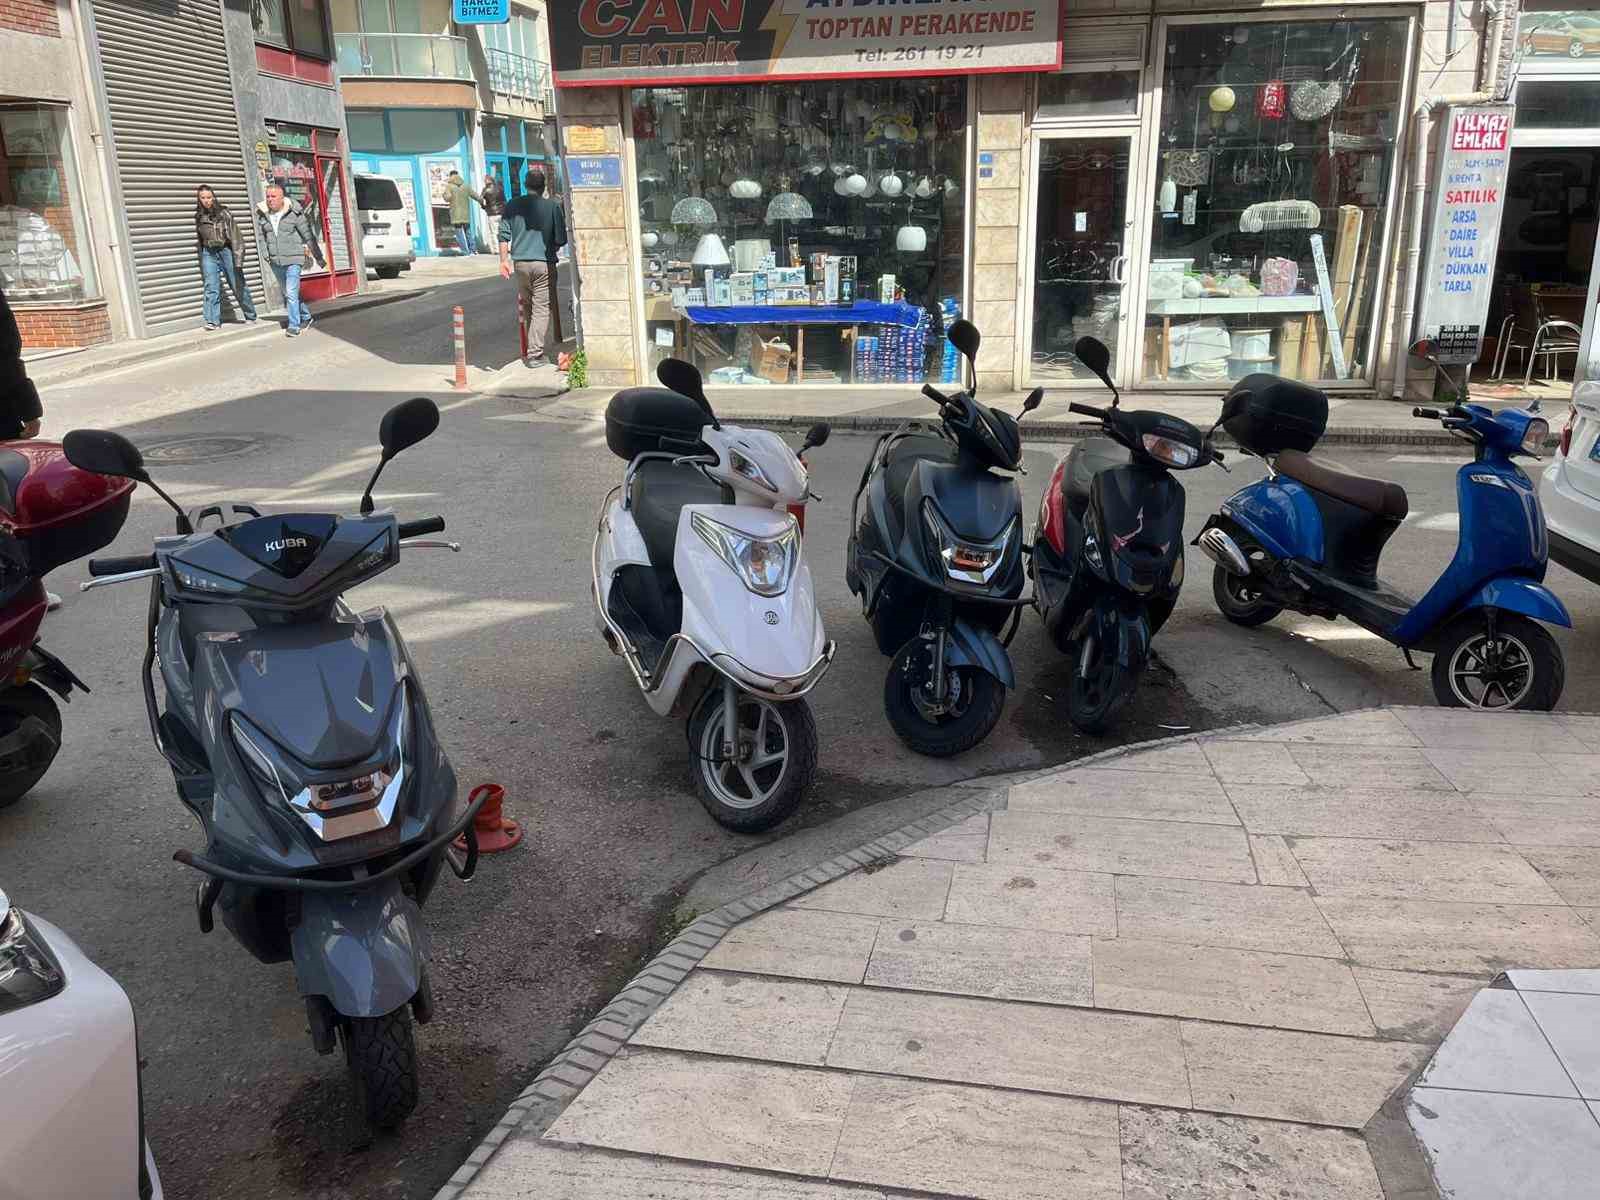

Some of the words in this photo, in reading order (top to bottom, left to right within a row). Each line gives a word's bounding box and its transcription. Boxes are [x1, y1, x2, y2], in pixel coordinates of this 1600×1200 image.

[578, 0, 746, 38] CAN
[806, 16, 893, 40] TOPTAN
[899, 10, 1035, 36] PERAKENDE
[581, 36, 741, 68] ELEKTRİK
[854, 49, 888, 63] Tel:
[893, 46, 927, 61] 261
[935, 45, 957, 60] 19
[962, 44, 985, 59] 21
[1453, 131, 1503, 149] EMLAK
[1445, 189, 1497, 204] SATILIK
[1452, 209, 1477, 224] ARSA
[1444, 280, 1472, 292] TARLA
[264, 537, 308, 552] KUBA
